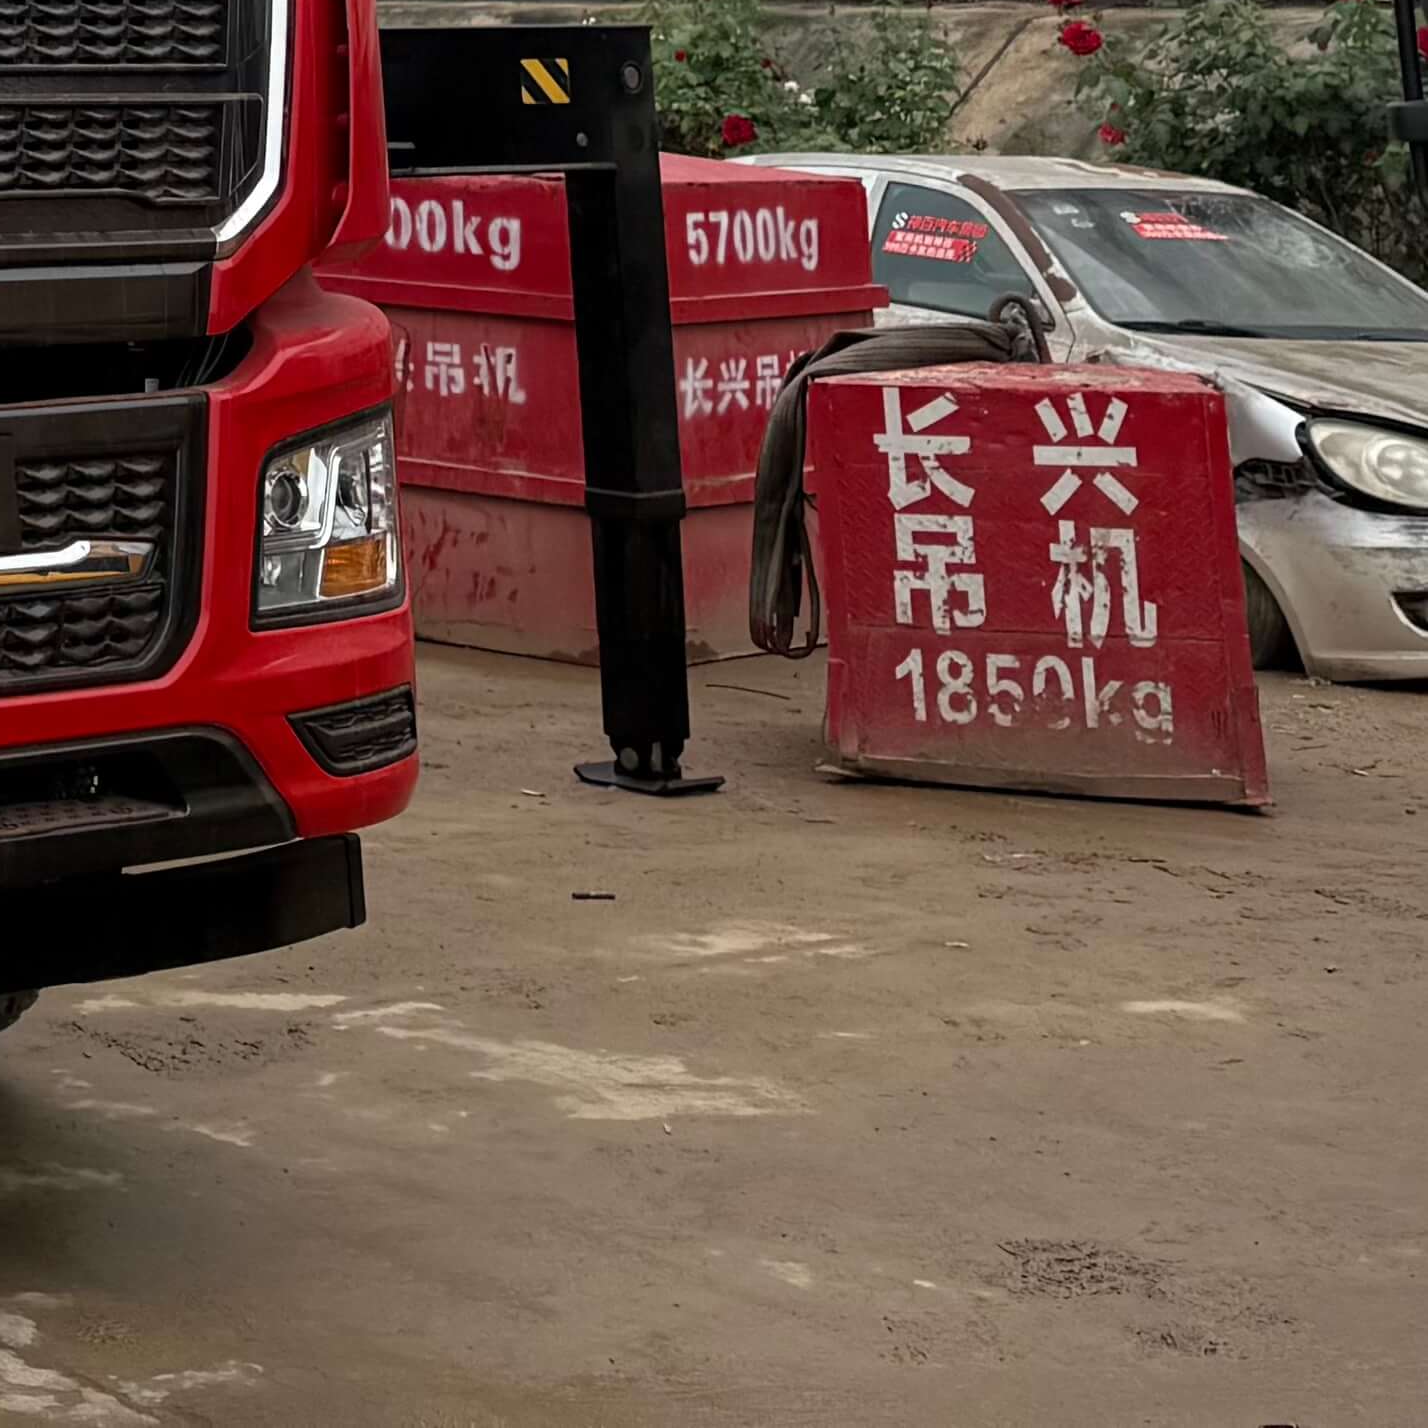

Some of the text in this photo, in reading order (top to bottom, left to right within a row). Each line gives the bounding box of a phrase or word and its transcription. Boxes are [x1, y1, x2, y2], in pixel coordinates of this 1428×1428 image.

[685, 206, 820, 271] 5700kg
[679, 349, 807, 421] 长兴吊
[873, 386, 1140, 515] 长兴
[894, 512, 1158, 648] 吊机
[895, 648, 1174, 745] 1850kg
